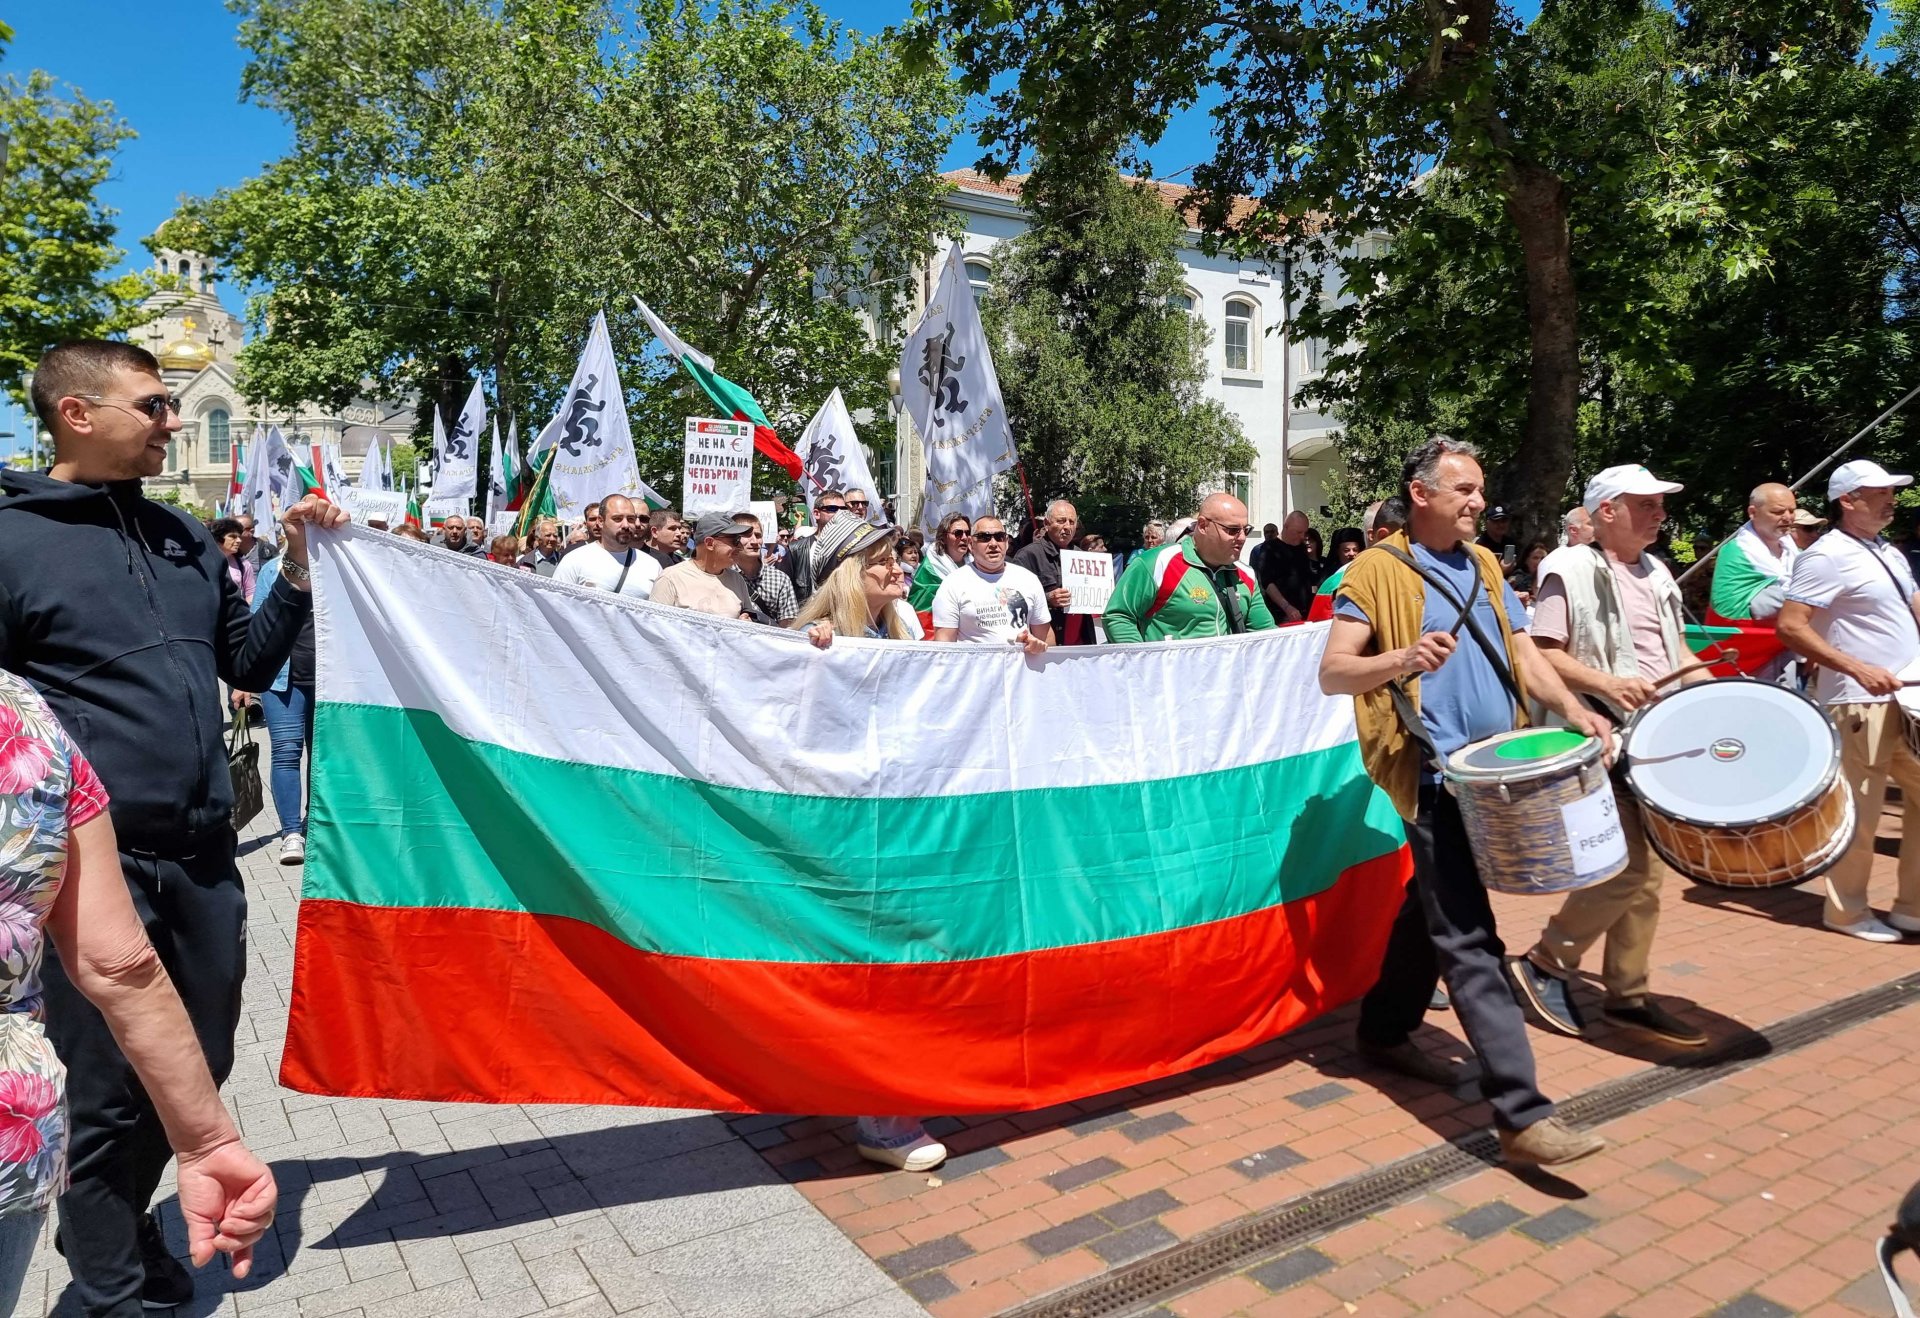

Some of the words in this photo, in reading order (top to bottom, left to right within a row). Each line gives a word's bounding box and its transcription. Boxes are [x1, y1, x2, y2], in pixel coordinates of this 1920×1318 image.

[698, 437, 709, 449] НЕ
[713, 438, 726, 449] НА
[689, 453, 736, 468] ВАЛУТАТА
[737, 457, 749, 468] НА
[688, 467, 738, 481] ЧЕТВЪРТИЯ
[692, 482, 716, 495] РАЙХ
[345, 490, 358, 502] АЗ
[357, 498, 399, 512] ИЗБИРАМ
[1069, 558, 1107, 577] ЛЕВЪТ
[1066, 578, 1113, 609] ВОБОДА!
[975, 605, 1003, 615] ВИНАГИ
